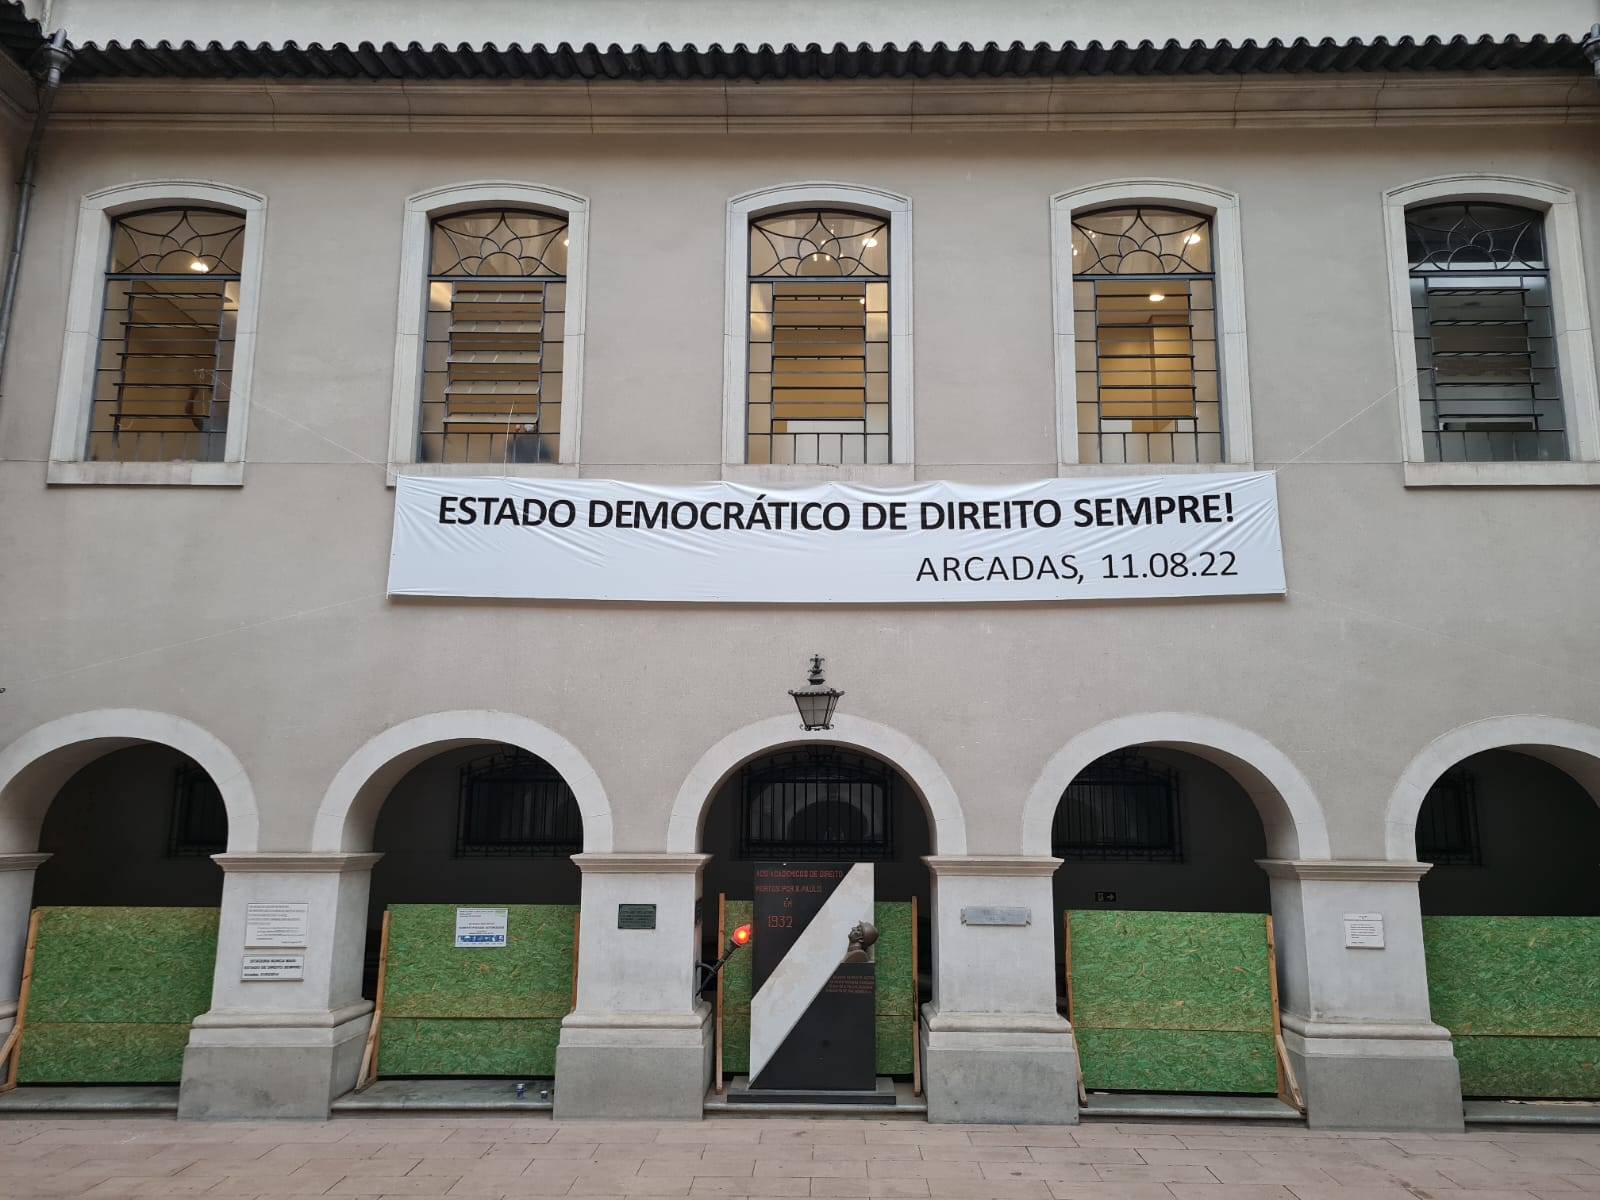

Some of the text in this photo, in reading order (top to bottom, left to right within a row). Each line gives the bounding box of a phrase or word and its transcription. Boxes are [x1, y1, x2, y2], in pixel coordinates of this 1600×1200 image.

[439, 493, 1234, 531] ESTADO DEMOCRÁTICO DE DIREITO SEMPRE!
[916, 550, 1238, 585] ARCADAS, 11.08.22
[768, 915, 793, 928] 1932
